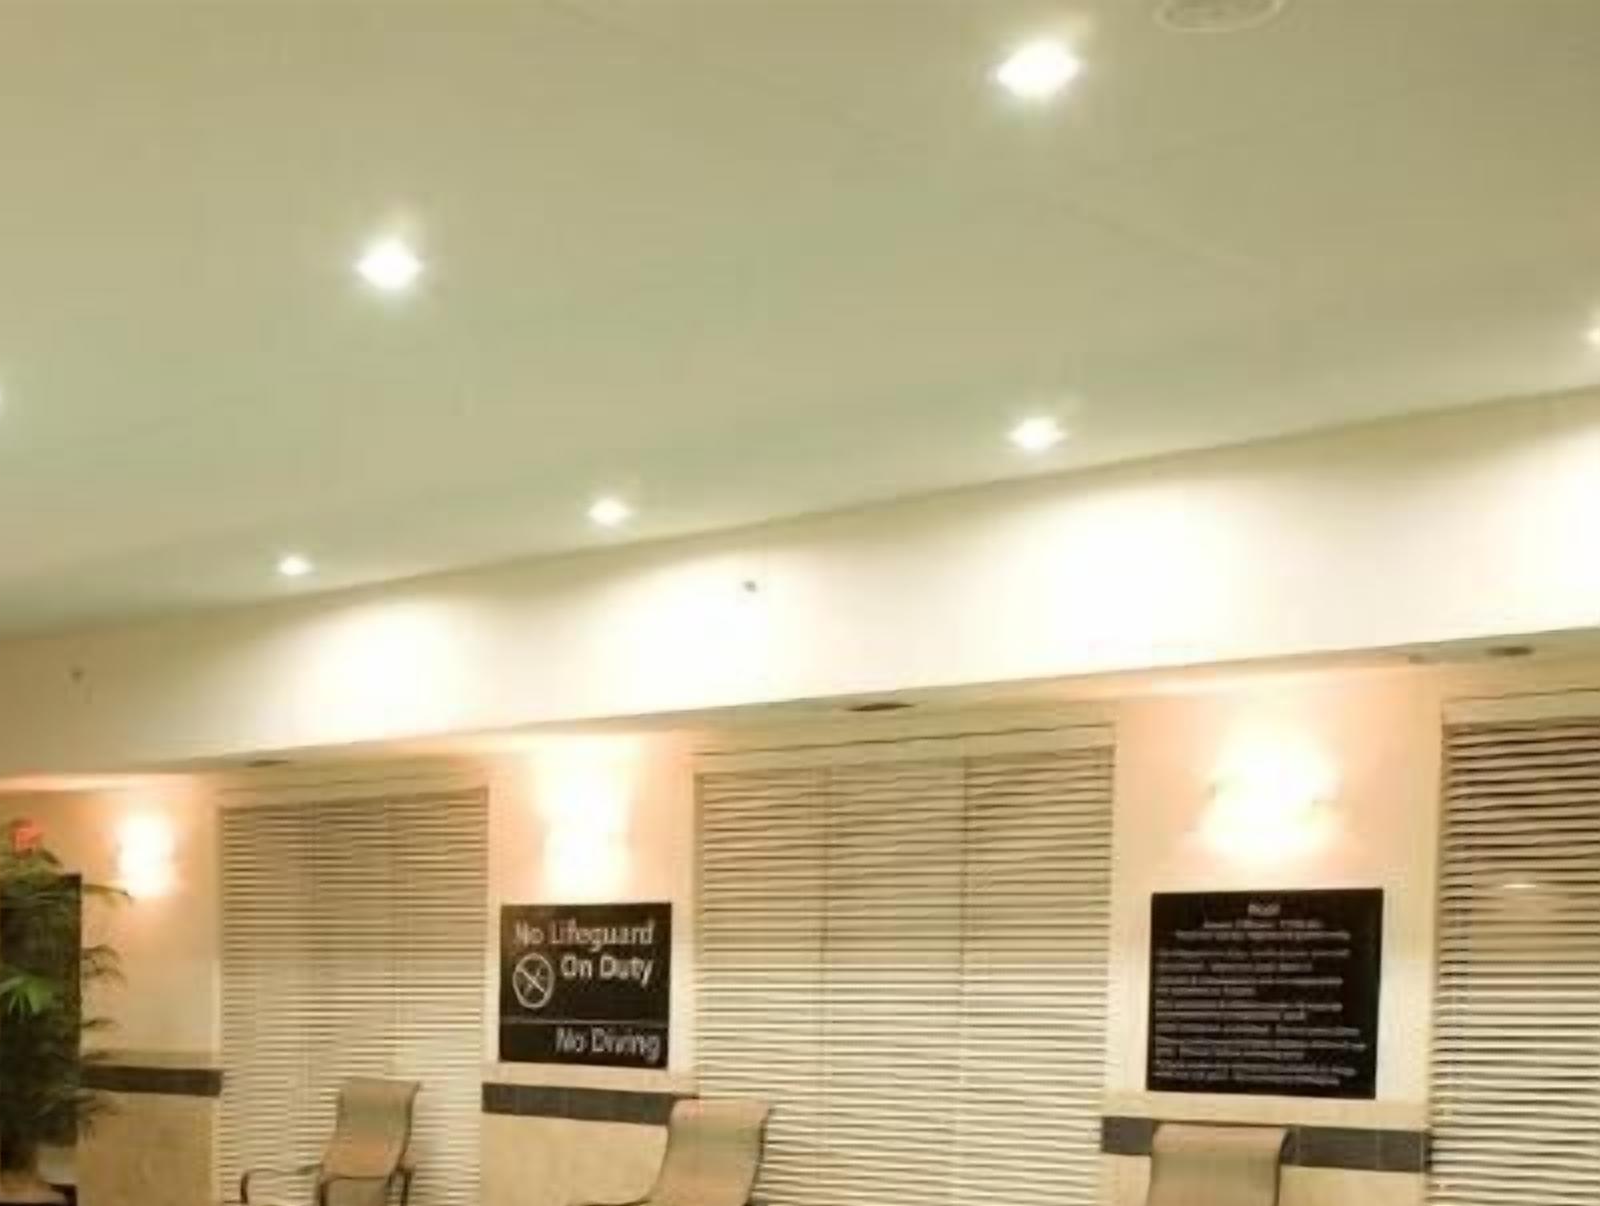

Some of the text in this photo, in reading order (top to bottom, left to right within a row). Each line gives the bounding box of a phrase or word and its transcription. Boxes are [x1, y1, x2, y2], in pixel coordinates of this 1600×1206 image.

[514, 918, 656, 953] No Lifeguard
[560, 954, 654, 989] On Duty
[555, 1026, 661, 1064] No Diving
